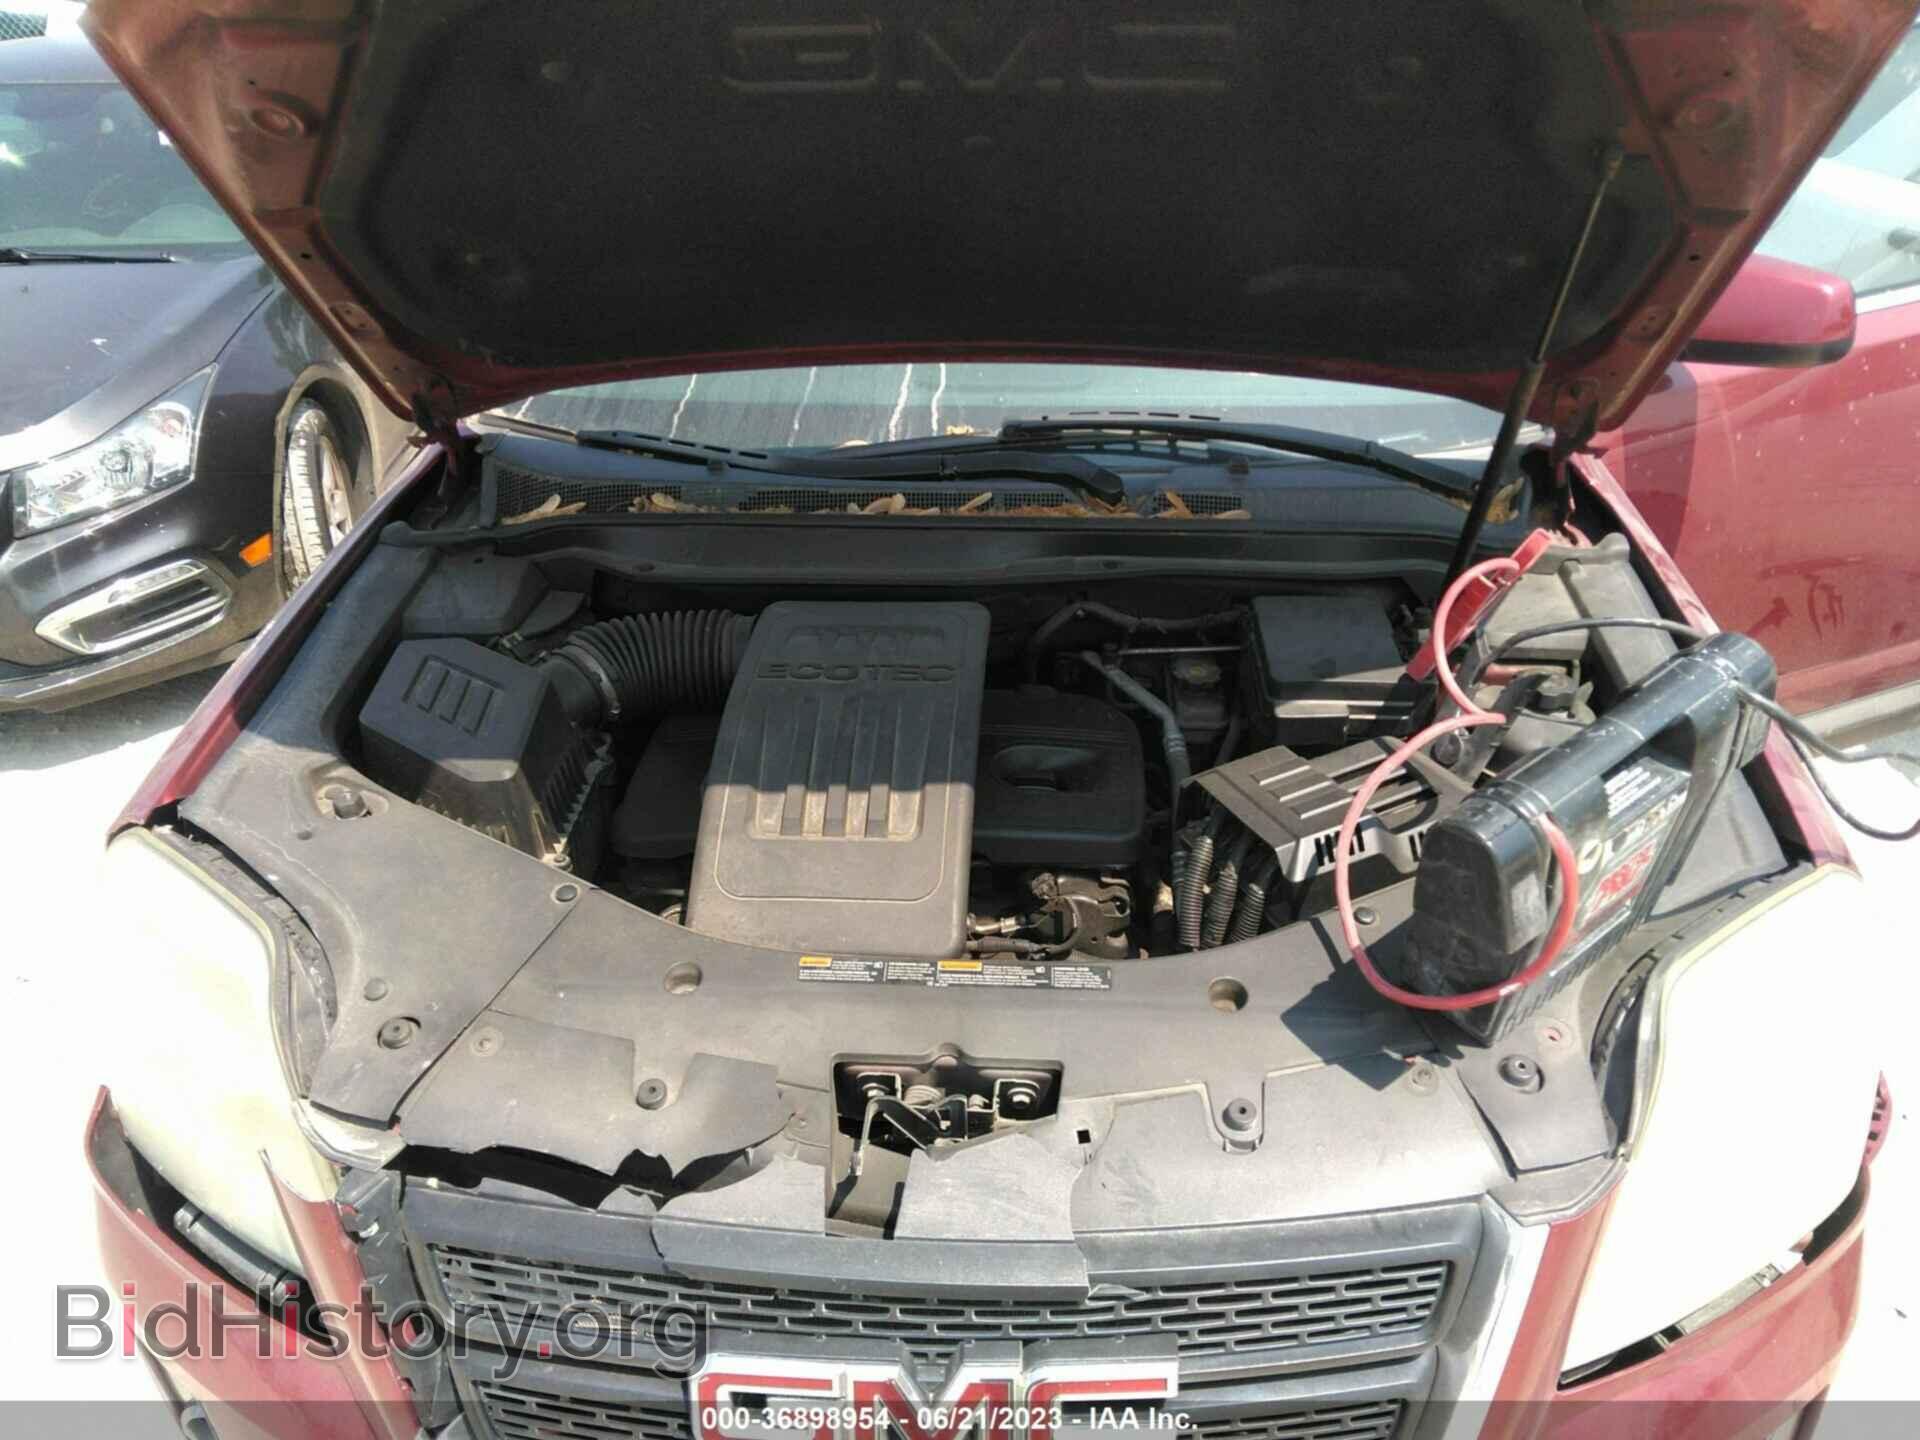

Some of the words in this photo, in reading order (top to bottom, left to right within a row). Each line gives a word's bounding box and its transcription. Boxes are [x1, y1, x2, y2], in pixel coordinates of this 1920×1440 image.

[722, 22, 1234, 94] GMC
[756, 662, 955, 683] ECOTEC
[688, 1352, 1179, 1440] GMC
